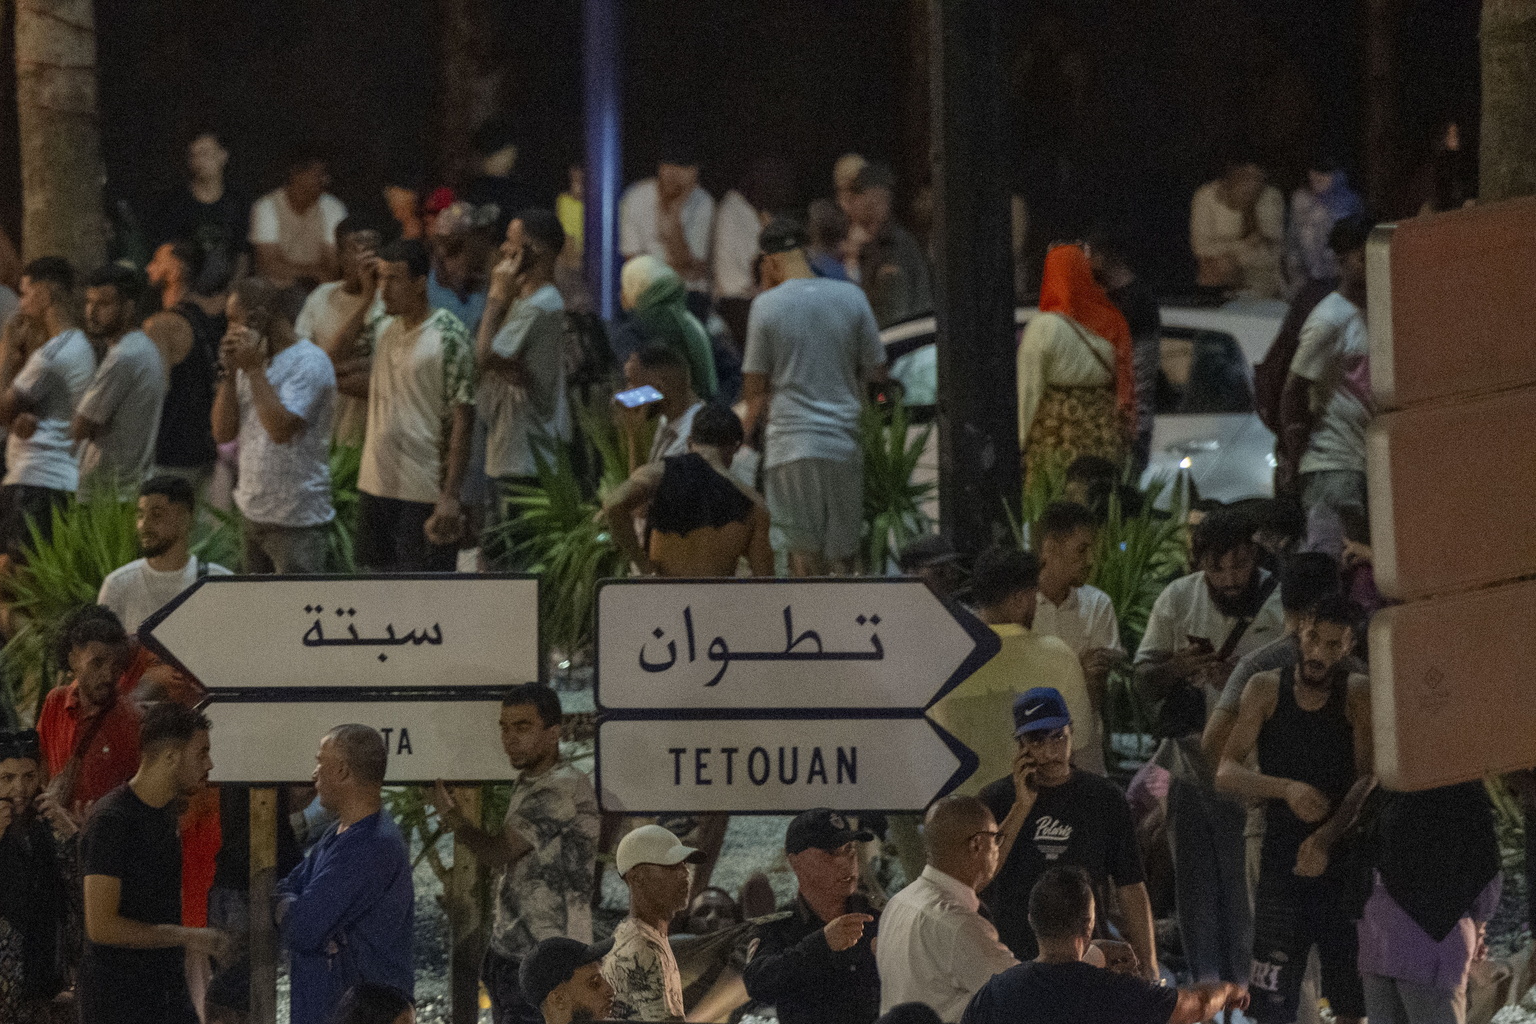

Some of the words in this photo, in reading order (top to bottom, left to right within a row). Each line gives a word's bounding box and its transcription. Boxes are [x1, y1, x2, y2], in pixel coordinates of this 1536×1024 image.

[301, 603, 443, 663] سبتة
[638, 605, 885, 687] تطوان
[667, 745, 858, 787] TETOUAN
